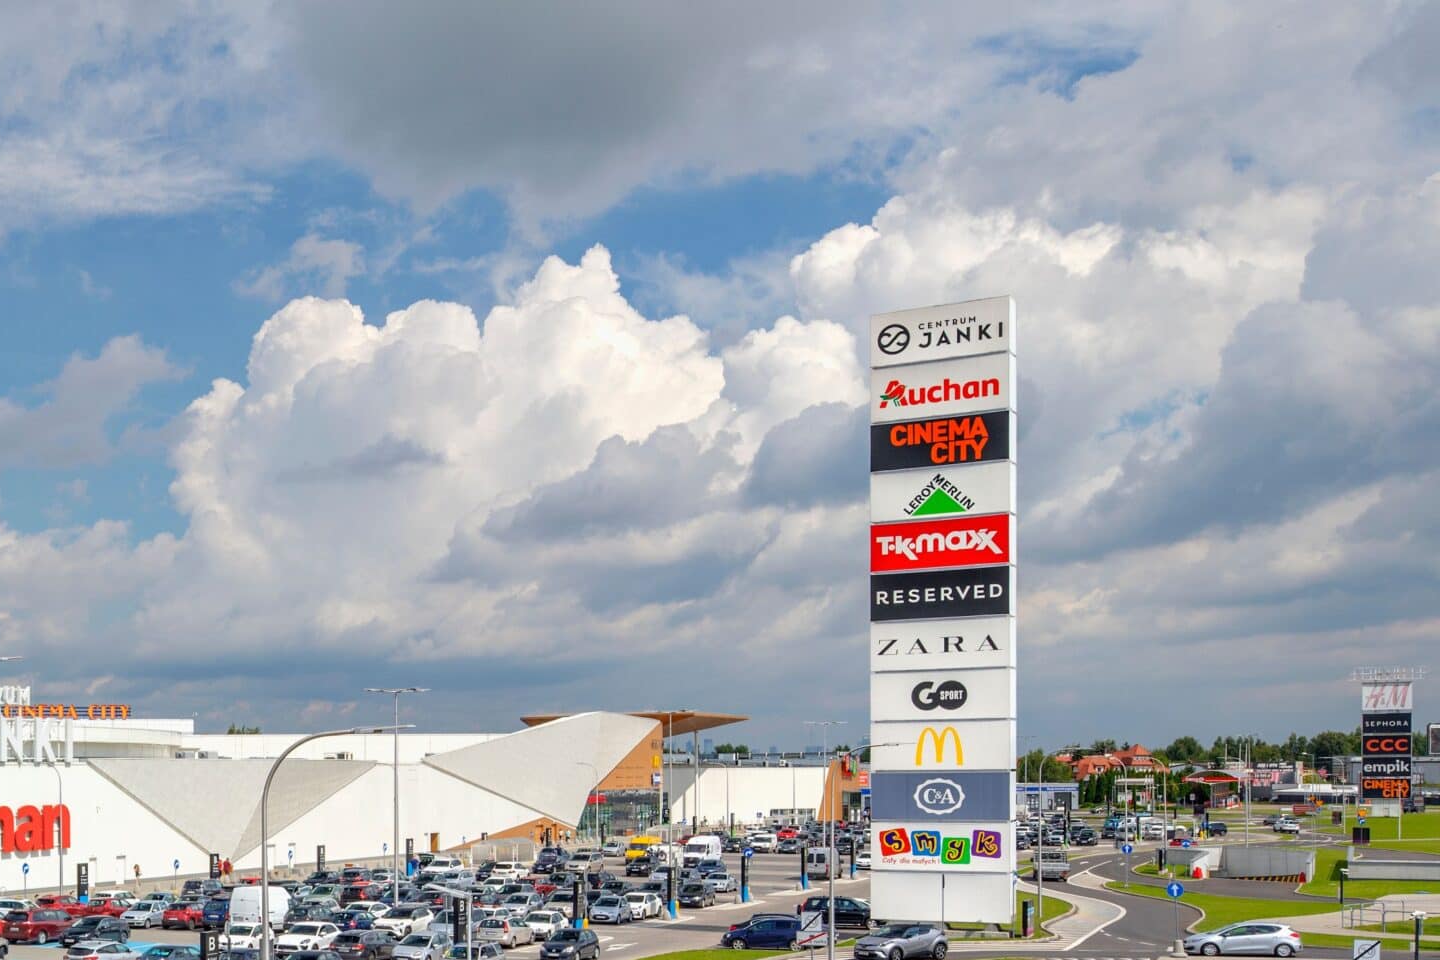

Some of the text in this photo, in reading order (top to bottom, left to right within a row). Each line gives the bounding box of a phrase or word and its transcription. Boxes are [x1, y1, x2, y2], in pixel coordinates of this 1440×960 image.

[918, 316, 976, 330] CENTRUM
[918, 322, 1004, 349] JANKI
[879, 378, 1000, 409] Auchan
[890, 416, 989, 447] CINEMA
[930, 436, 989, 464] CITY
[903, 473, 976, 516] LEROY MERLIN
[876, 583, 1004, 605] RESERVED
[876, 634, 1003, 656] ZARA
[939, 689, 964, 701] SPORT
[3, 704, 130, 720] CINEMA CITY
[1365, 720, 1409, 728] SEPHORA
[1365, 738, 1409, 752] CCC
[1364, 759, 1409, 774] empik
[1364, 779, 1409, 790] CINEMA
[923, 788, 956, 805] C&A
[1382, 788, 1409, 798] CITY
[880, 828, 1002, 865] smyk
[209, 936, 216, 951] B
